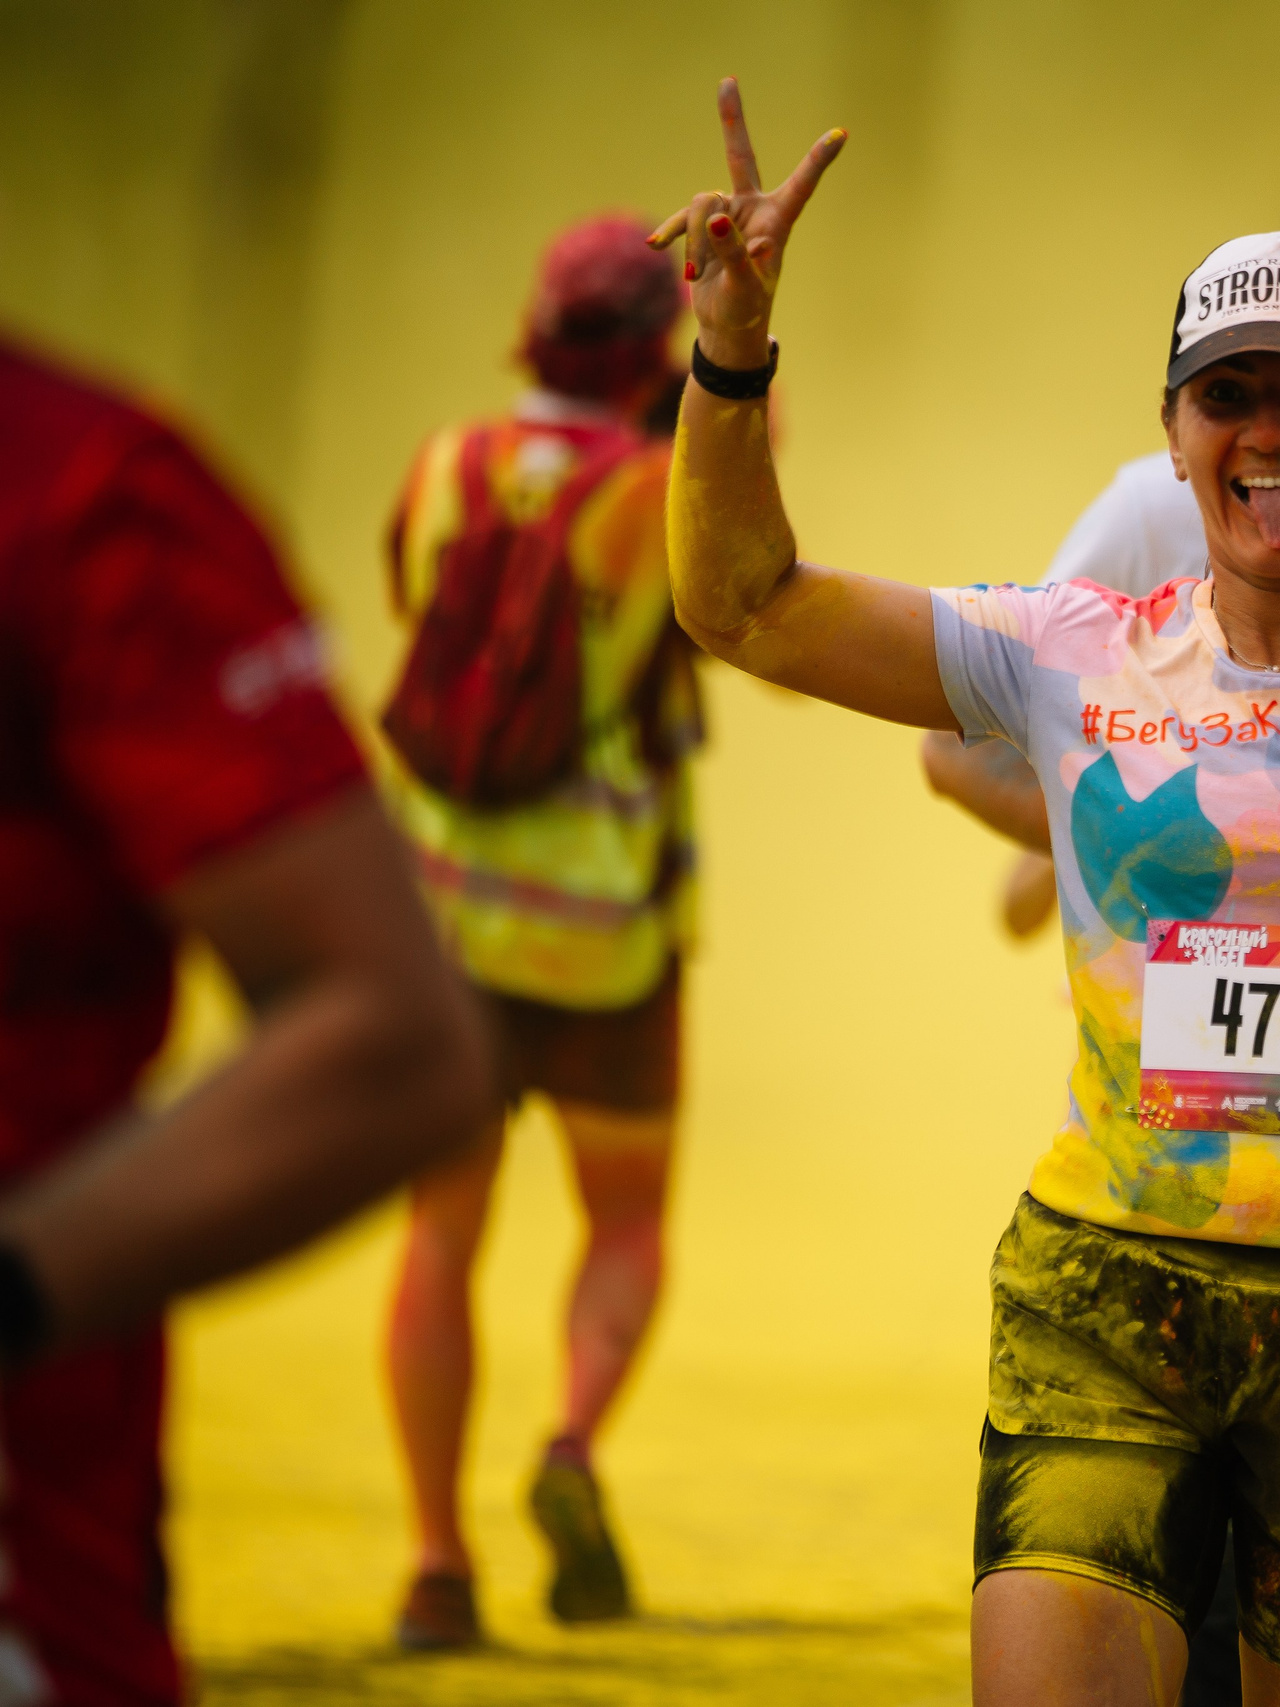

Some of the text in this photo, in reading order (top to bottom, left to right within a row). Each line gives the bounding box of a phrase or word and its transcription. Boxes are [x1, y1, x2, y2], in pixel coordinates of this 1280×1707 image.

[1227, 258, 1263, 272] CITY
[1221, 306, 1248, 318] JUST
[1177, 926, 1268, 949] КРАСОЧНЫЙ
[1191, 944, 1252, 967] ЗАБЕГ
